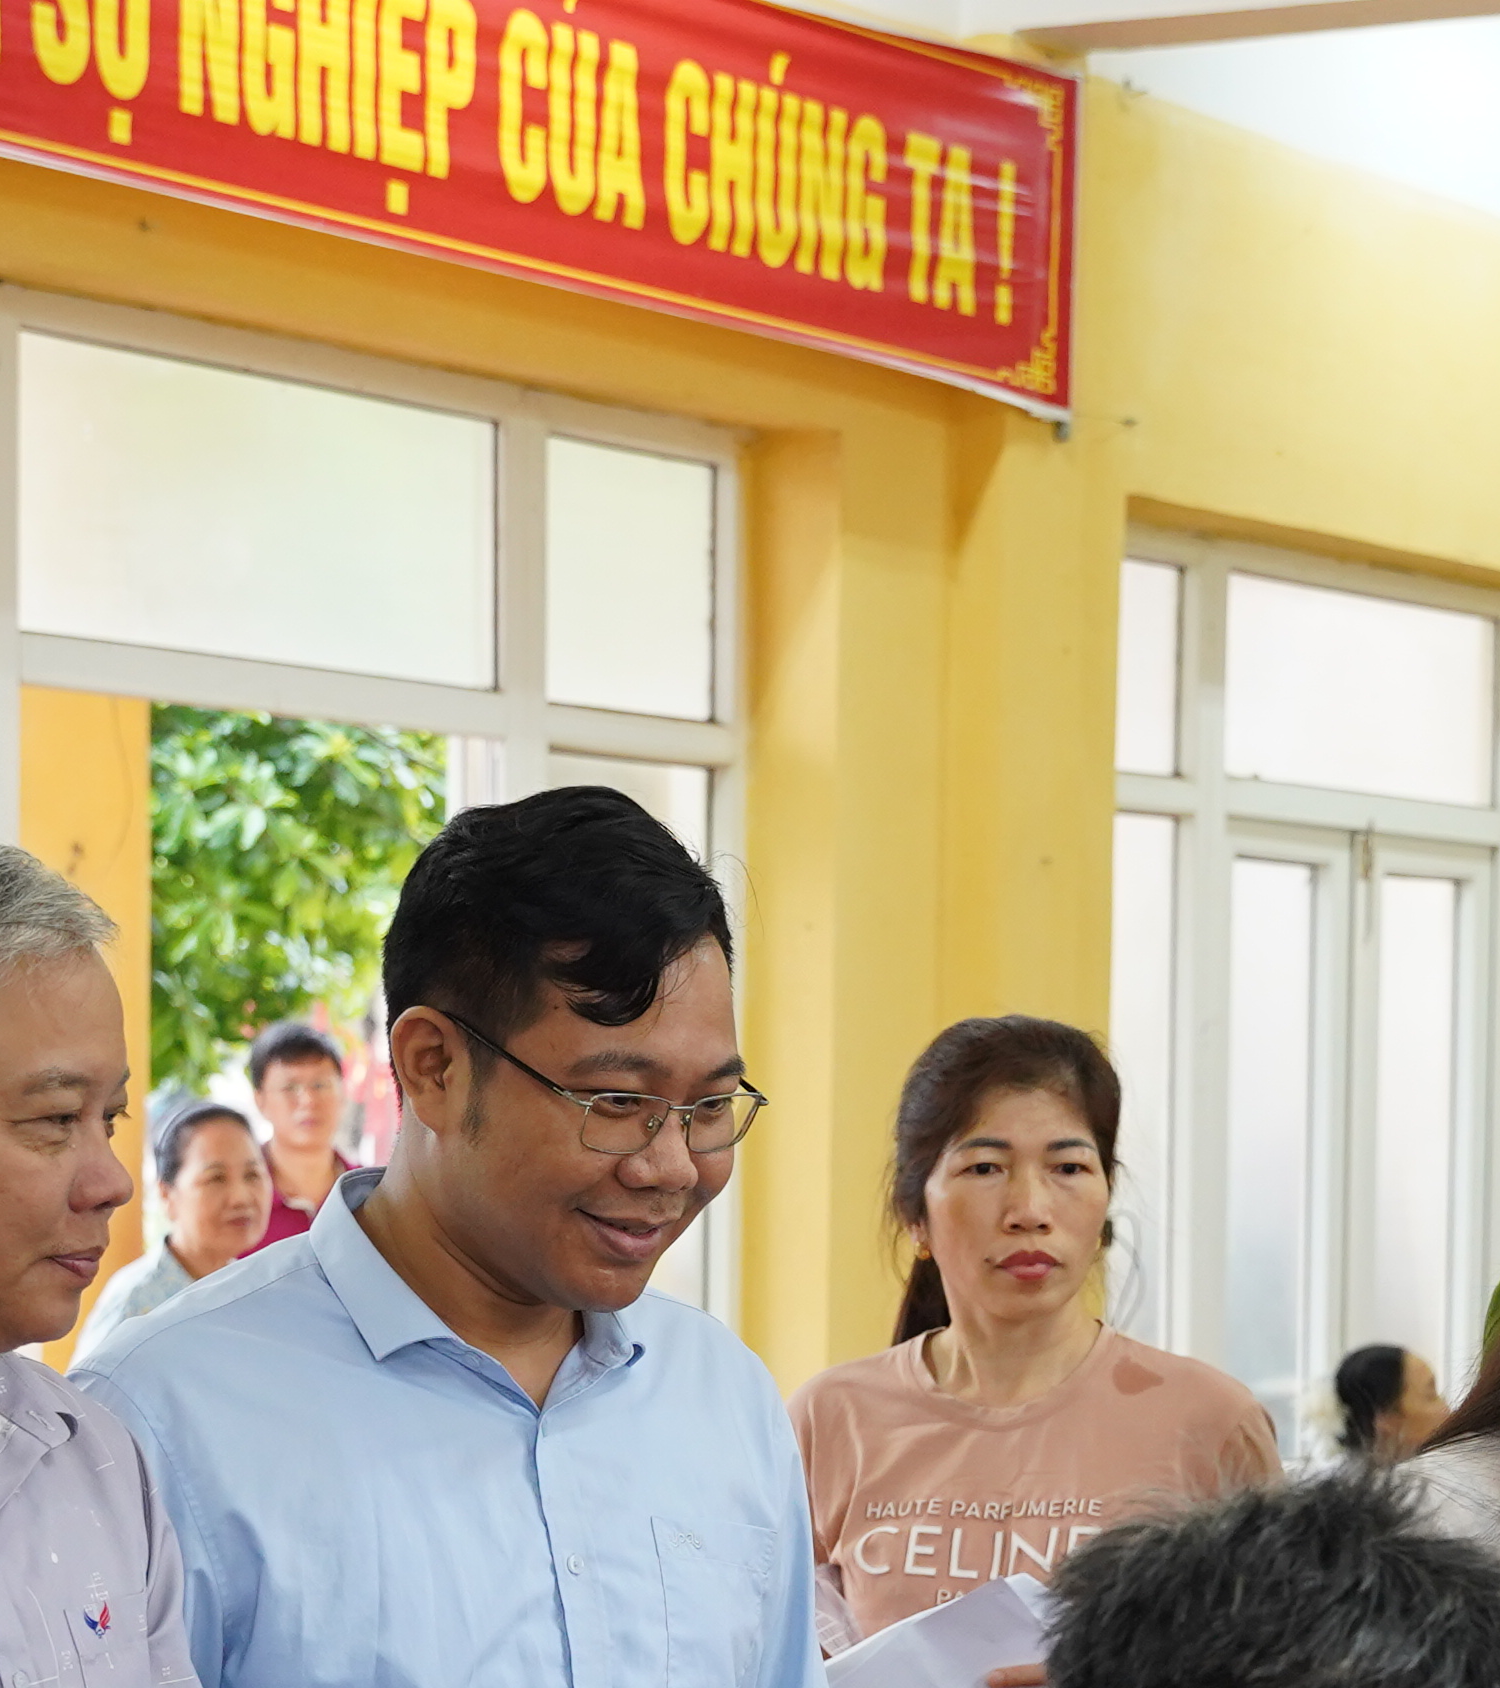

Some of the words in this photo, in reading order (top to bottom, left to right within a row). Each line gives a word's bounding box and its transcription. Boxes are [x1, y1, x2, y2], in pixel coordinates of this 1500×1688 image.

[664, 51, 888, 292] CHÚNG
[903, 130, 977, 317] TA
[865, 1498, 943, 1519] HAUTE
[950, 1498, 1104, 1520] PARFUMERIE
